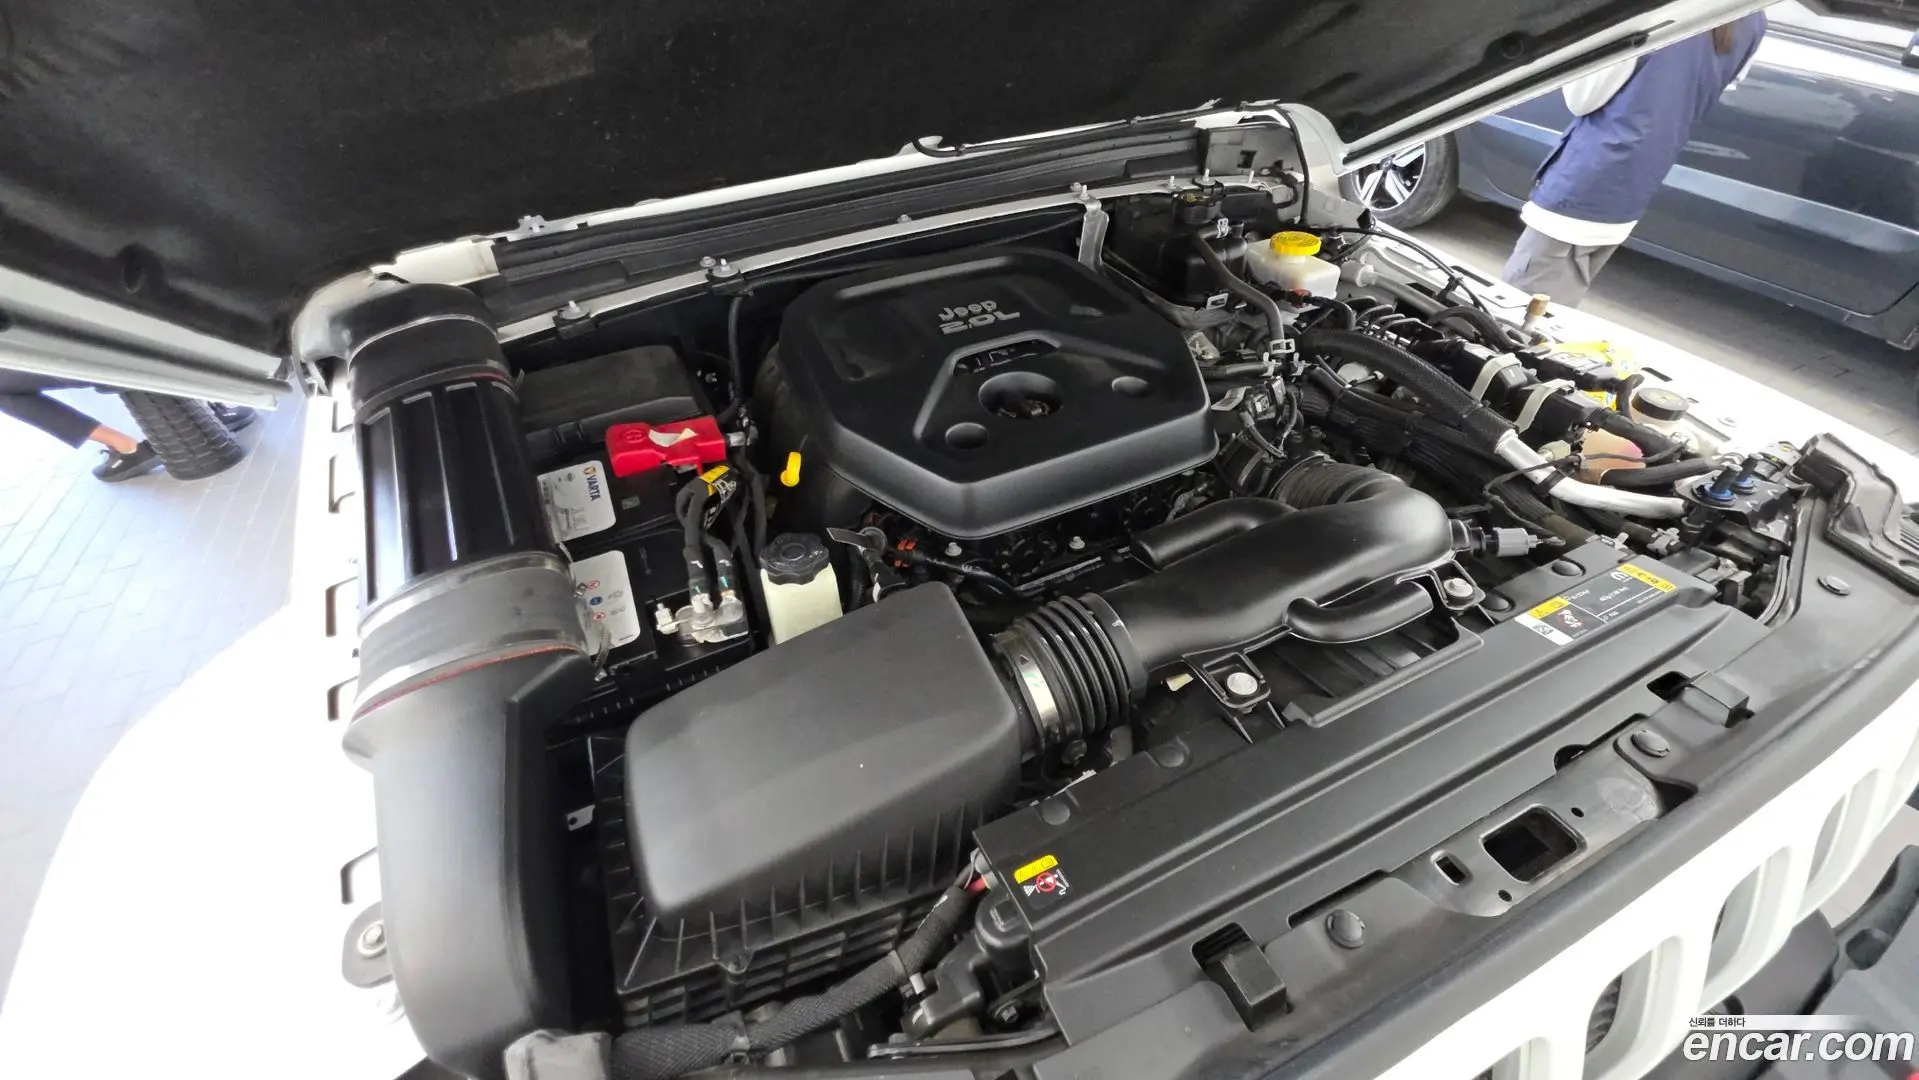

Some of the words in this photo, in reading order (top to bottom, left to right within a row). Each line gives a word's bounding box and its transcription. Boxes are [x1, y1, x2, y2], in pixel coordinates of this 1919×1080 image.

[937, 300, 997, 321] Jeep
[939, 311, 1021, 335] 2.0L
[587, 475, 601, 501] VARTA
